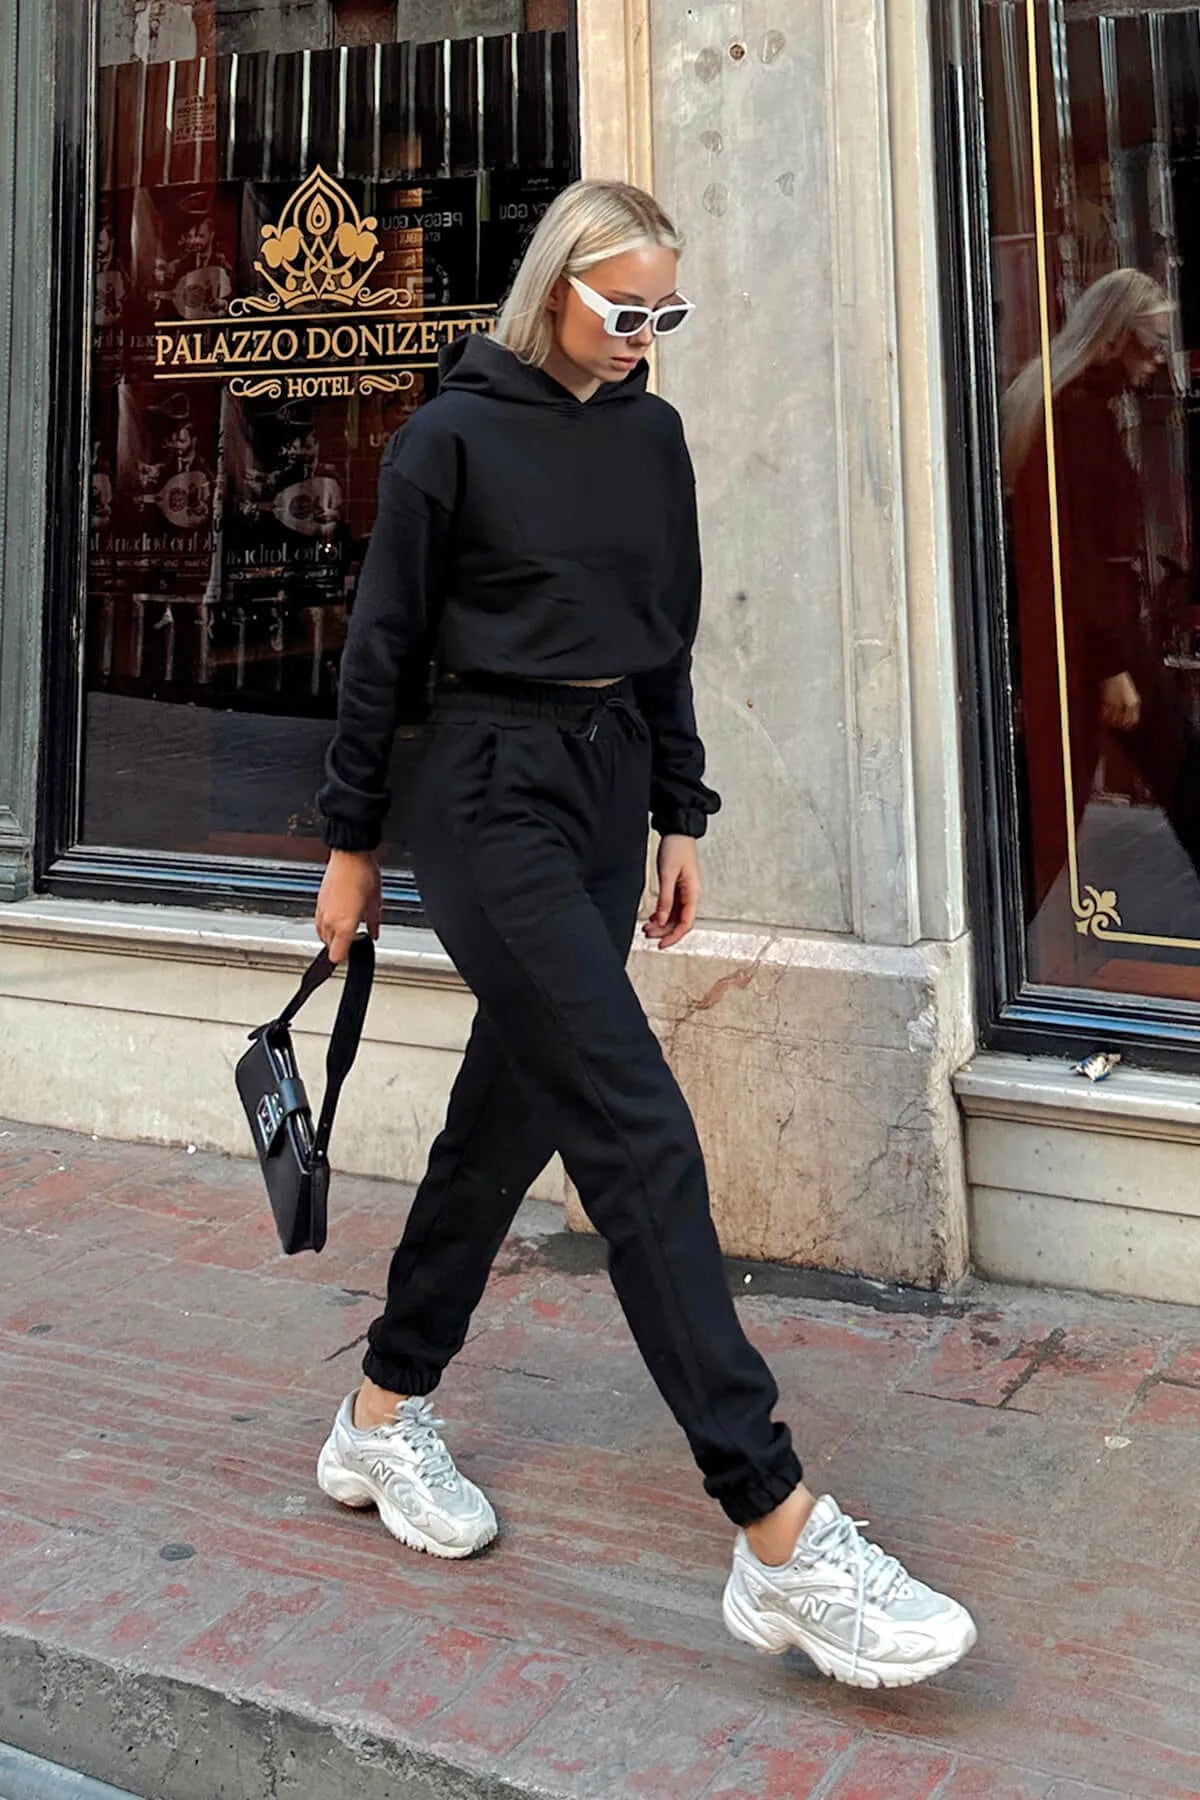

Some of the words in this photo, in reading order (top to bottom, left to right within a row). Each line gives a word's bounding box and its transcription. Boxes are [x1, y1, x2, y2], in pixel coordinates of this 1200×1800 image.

[154, 328, 298, 366] PALAZZO
[287, 376, 355, 398] HOTEL
[370, 1460, 394, 1486] N
[800, 1594, 830, 1624] N
